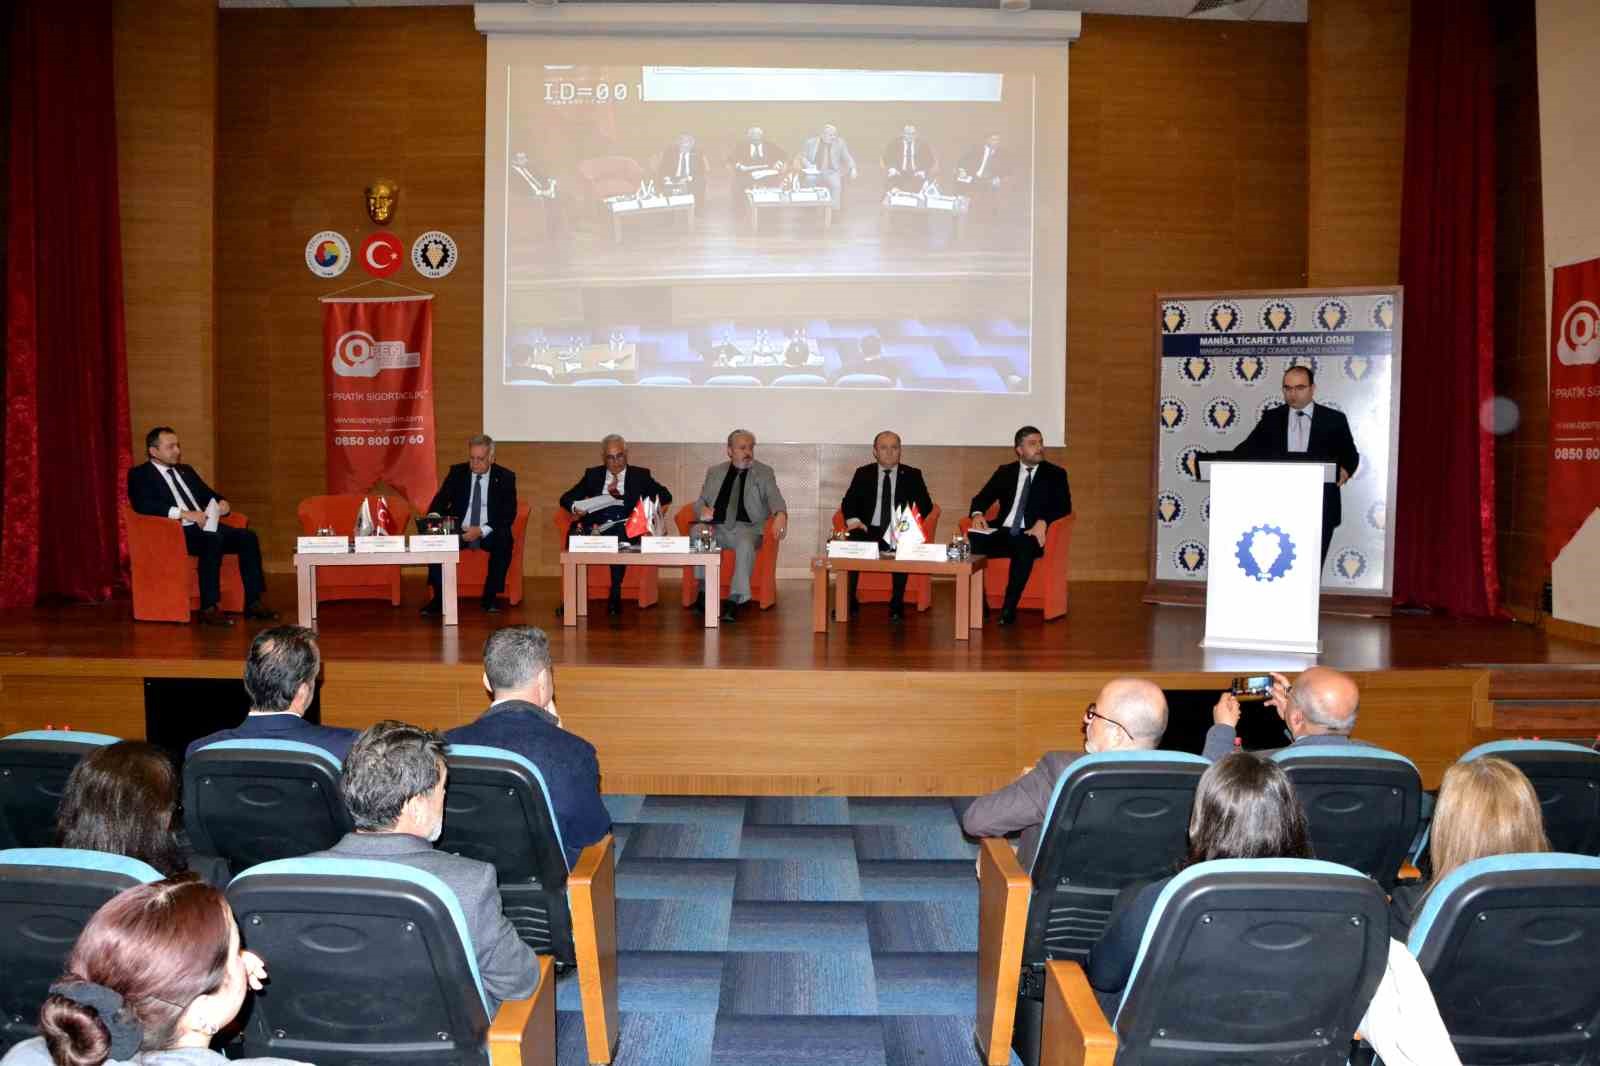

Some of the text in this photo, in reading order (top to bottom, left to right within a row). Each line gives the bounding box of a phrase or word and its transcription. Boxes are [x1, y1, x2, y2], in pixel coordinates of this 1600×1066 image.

[1200, 334, 1354, 345] MANİSA TİCARET VE SANAYİ ODASI
[335, 436, 365, 446] 0850
[1554, 447, 1583, 460] 0850
